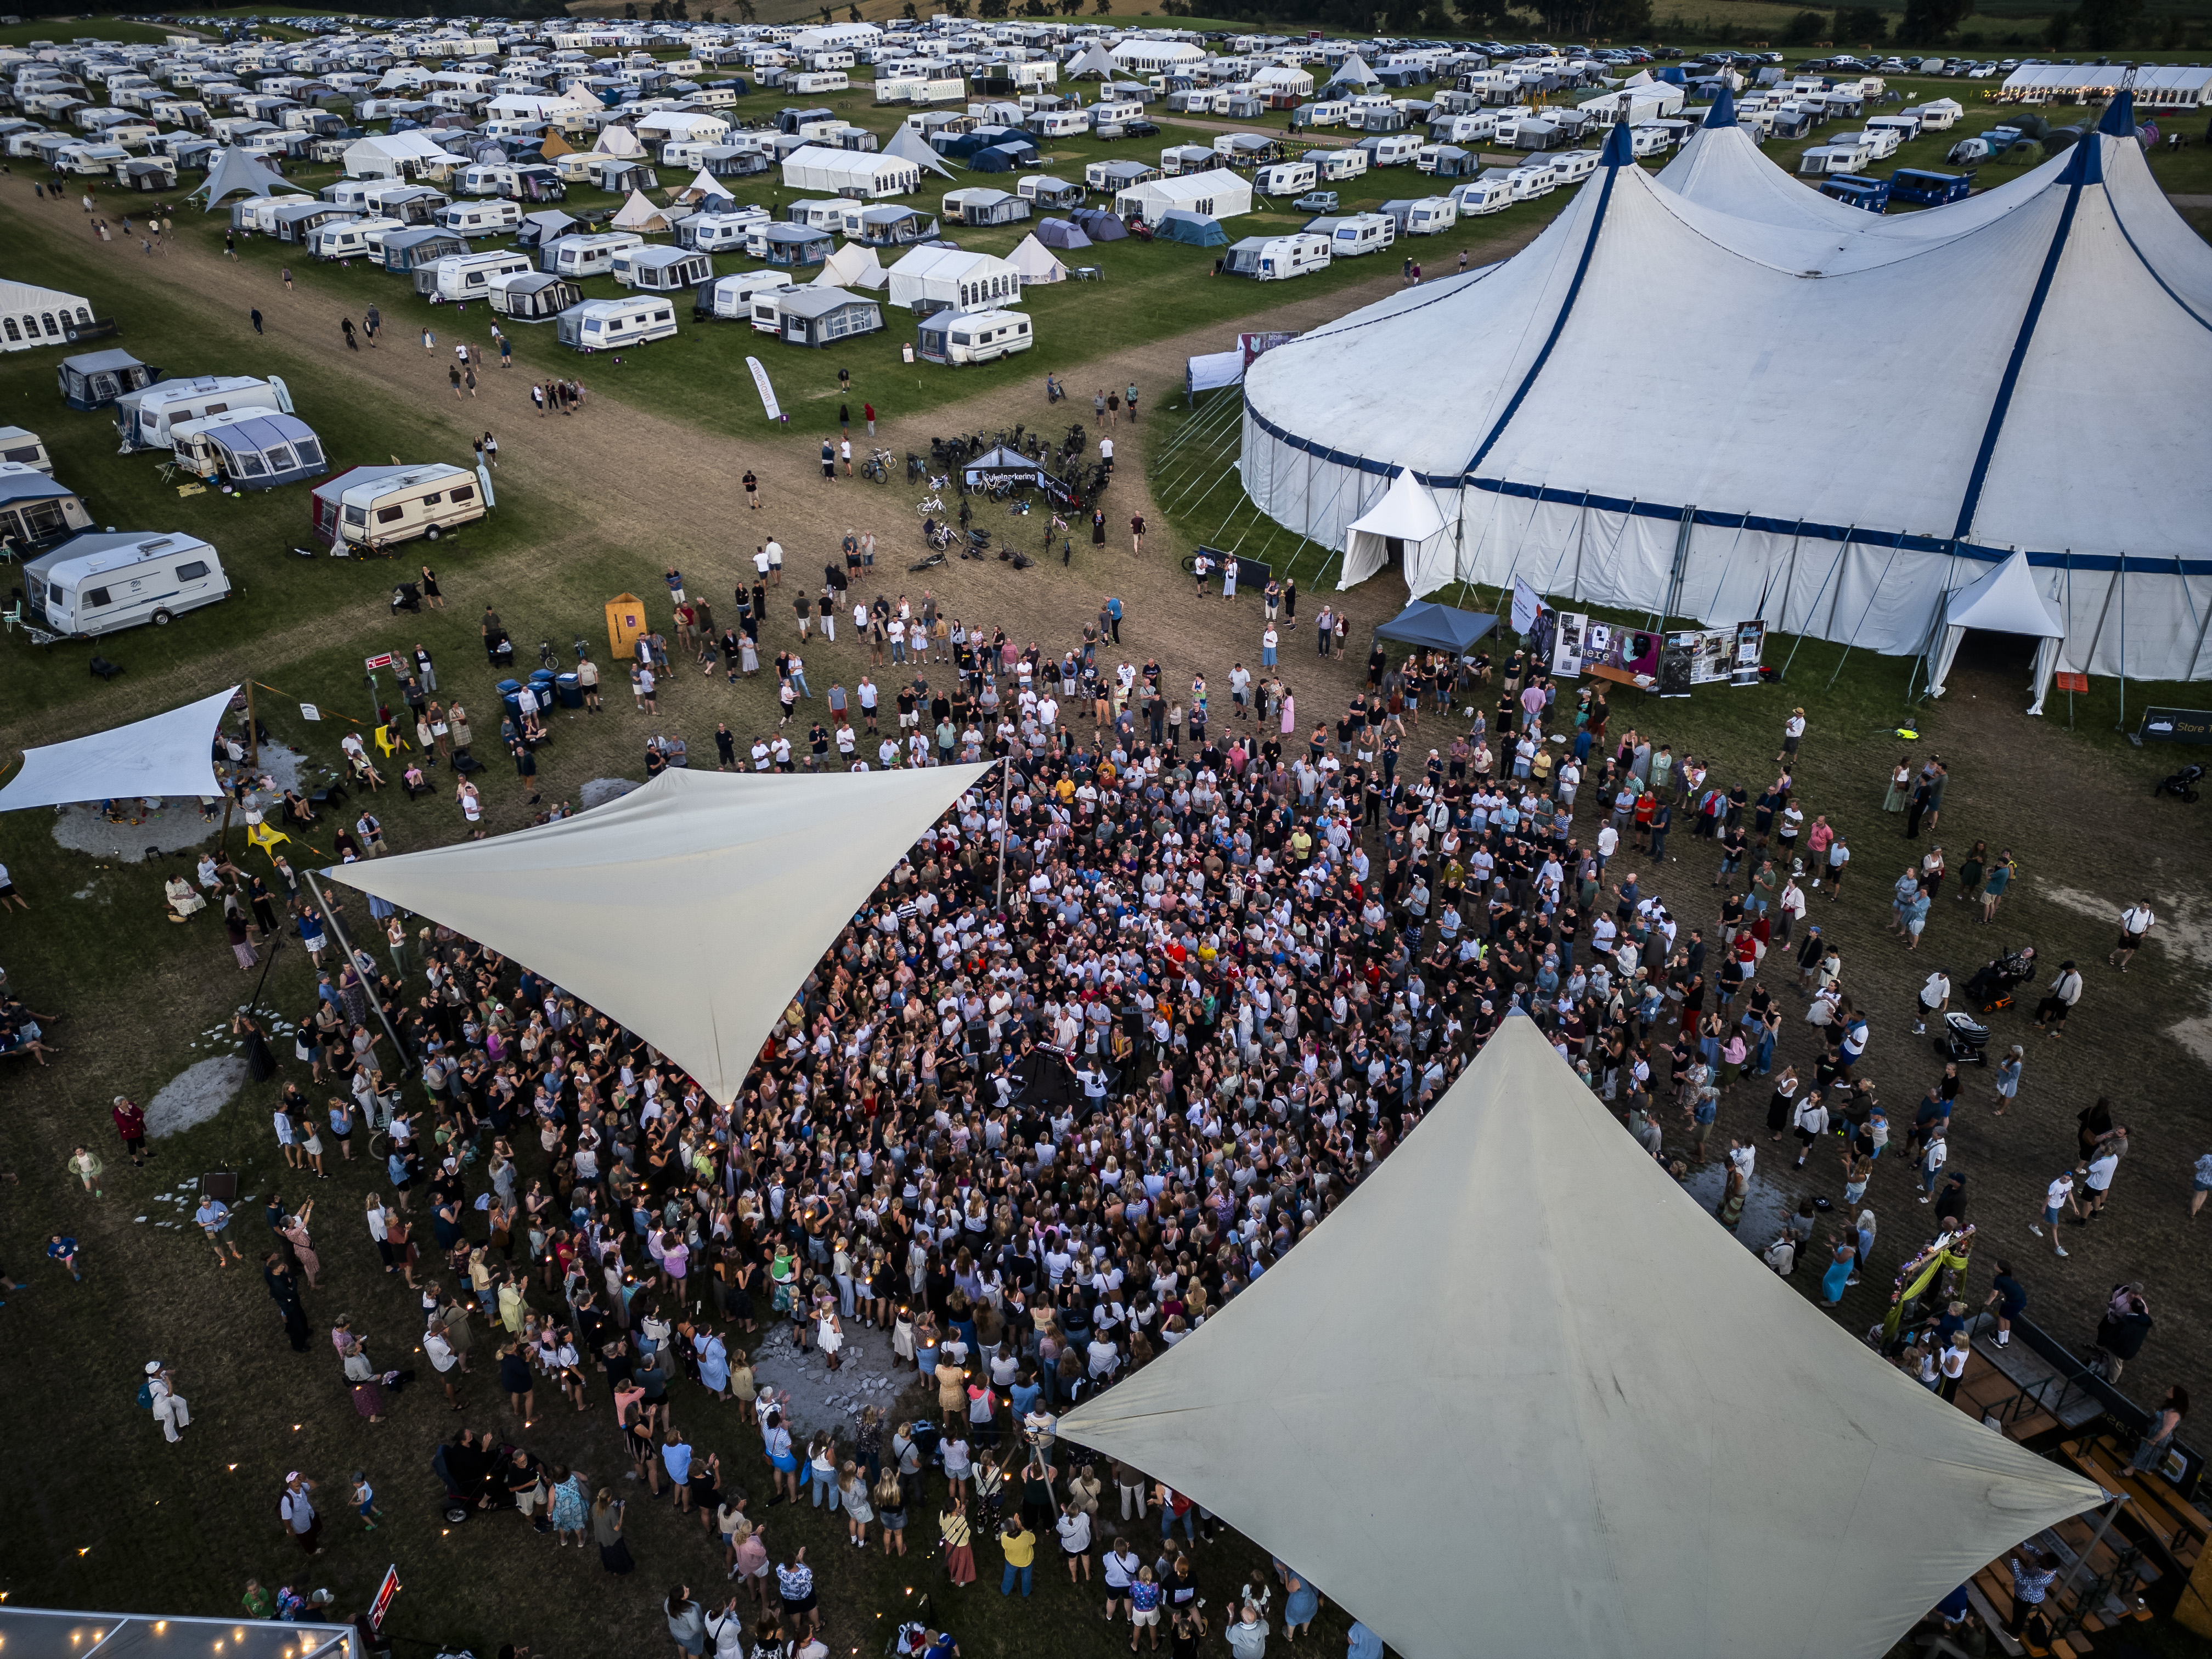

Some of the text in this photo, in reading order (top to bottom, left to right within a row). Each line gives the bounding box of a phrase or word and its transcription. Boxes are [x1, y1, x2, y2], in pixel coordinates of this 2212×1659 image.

[986, 473, 1035, 482] Cykelparkering
[1605, 640, 1618, 652] il
[2177, 722, 2204, 732] Store
